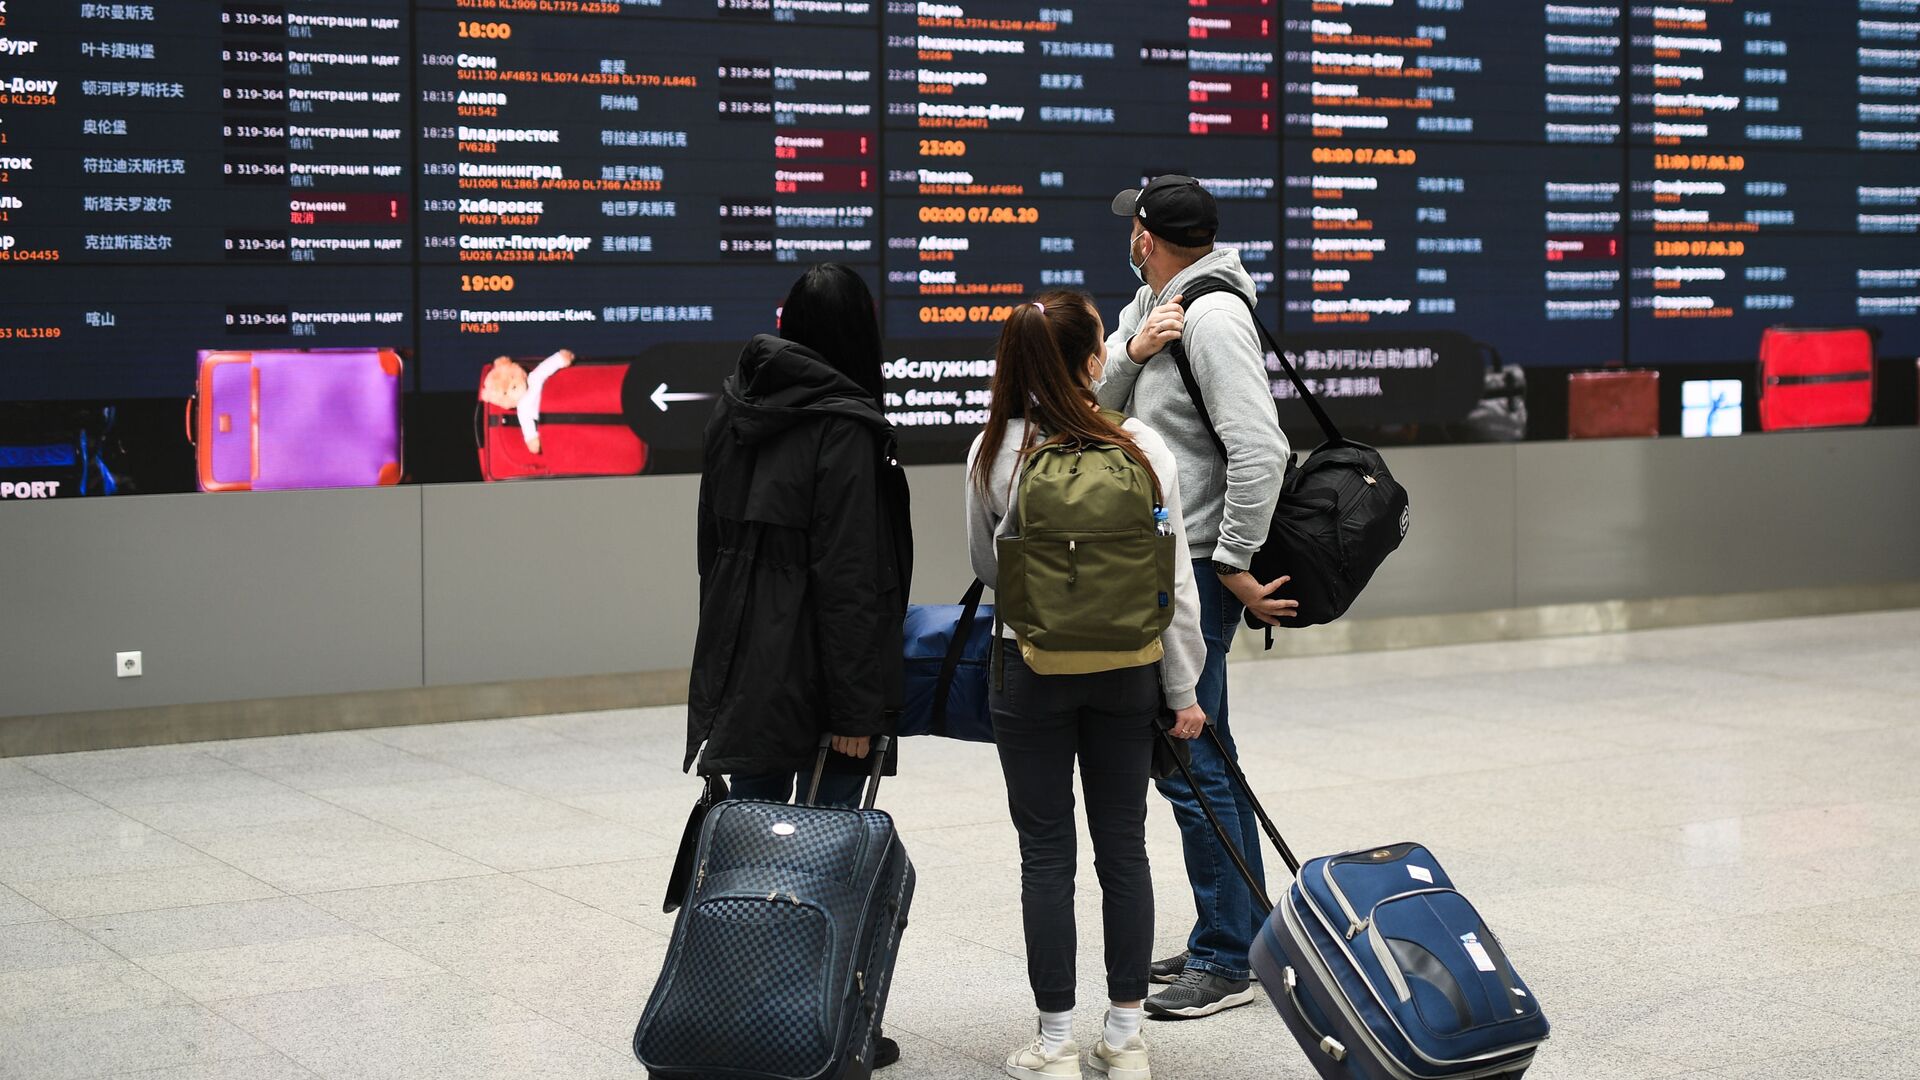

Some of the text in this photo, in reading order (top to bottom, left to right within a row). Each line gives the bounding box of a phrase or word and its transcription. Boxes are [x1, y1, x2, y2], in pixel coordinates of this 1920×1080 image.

[81, 4, 154, 20] 摩尔曼斯克
[236, 13, 282, 24] 319-364
[288, 14, 399, 29] Регистрация идет
[459, 22, 511, 39] 18:00
[82, 42, 154, 58] 叶卡捷琳堡
[237, 51, 283, 62] 319-364
[289, 51, 400, 66] Регистрация идет
[423, 54, 454, 65] 18:00
[457, 54, 496, 68] Сочи
[82, 81, 183, 97] 顿河畔罗斯托夫
[237, 89, 283, 99] 319-364
[289, 89, 400, 103] Регистрация идет
[12, 94, 56, 105] KL2954
[423, 91, 454, 102] 18:15
[457, 91, 507, 105] Анапа
[458, 106, 496, 116] SU1542
[84, 119, 127, 134] 奥伦堡
[238, 127, 284, 137] 319-364
[290, 126, 400, 140] Регистрация идет
[424, 127, 454, 138] 18:25
[459, 126, 559, 144] Владивосток
[459, 142, 496, 152] FV6281
[920, 140, 965, 156] 23:00
[84, 158, 185, 173] 符拉迪沃斯托克
[238, 164, 284, 174] 319-364
[290, 163, 401, 177] Регистрация идет
[424, 164, 455, 174] 18:30
[459, 163, 563, 180] Калининград
[0, 197, 22, 208] ль
[84, 197, 171, 211] 斯塔夫罗波尔
[290, 201, 346, 211] Отменен
[425, 200, 456, 211] 18:30
[459, 199, 544, 216] Хабаровск
[919, 207, 1038, 223] 00:00 07.06.20
[86, 235, 171, 249] 克拉斯诺达尔
[239, 239, 285, 249] 319-364
[291, 238, 402, 250] Регистрация идет
[425, 237, 456, 247] 18:45
[459, 235, 591, 252] Санкт-Петербург
[14, 250, 59, 260] LO4455
[462, 275, 514, 291] 19:00
[86, 312, 114, 326] 喀山
[240, 314, 286, 324] 319-364
[292, 312, 403, 324] Регистрация идет
[426, 309, 457, 320] 19:50
[461, 309, 596, 324] Петропавловск-Кмч.
[920, 307, 967, 322] 01:00
[16, 328, 61, 338] KL3189
[904, 388, 962, 407] багаж,
[0, 481, 60, 498] PORT
